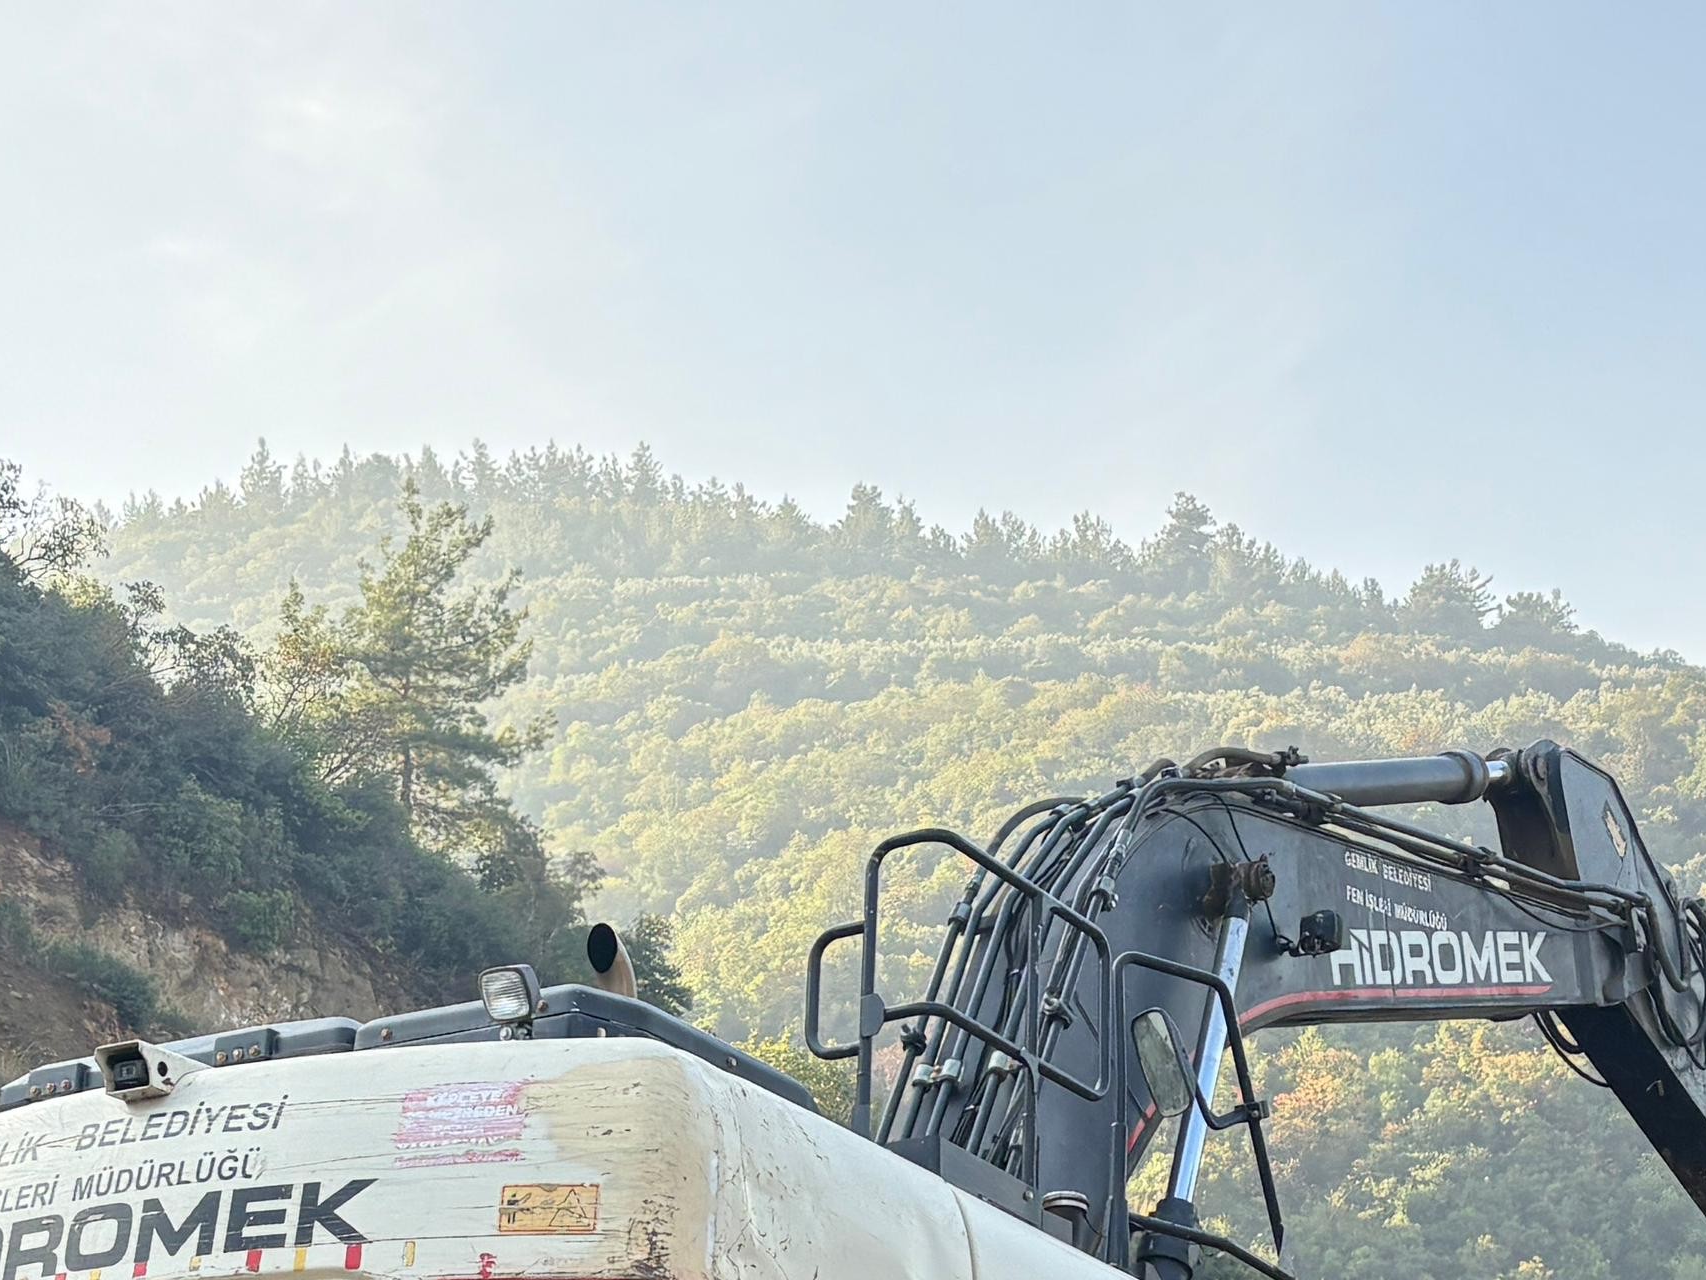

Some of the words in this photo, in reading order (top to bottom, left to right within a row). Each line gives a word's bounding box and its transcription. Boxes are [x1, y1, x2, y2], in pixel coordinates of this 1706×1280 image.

[1346, 884, 1364, 906] FEN
[75, 1094, 289, 1152] BELEDİYESİ
[71, 1147, 264, 1202] MÜDÜRLÜĞÜ
